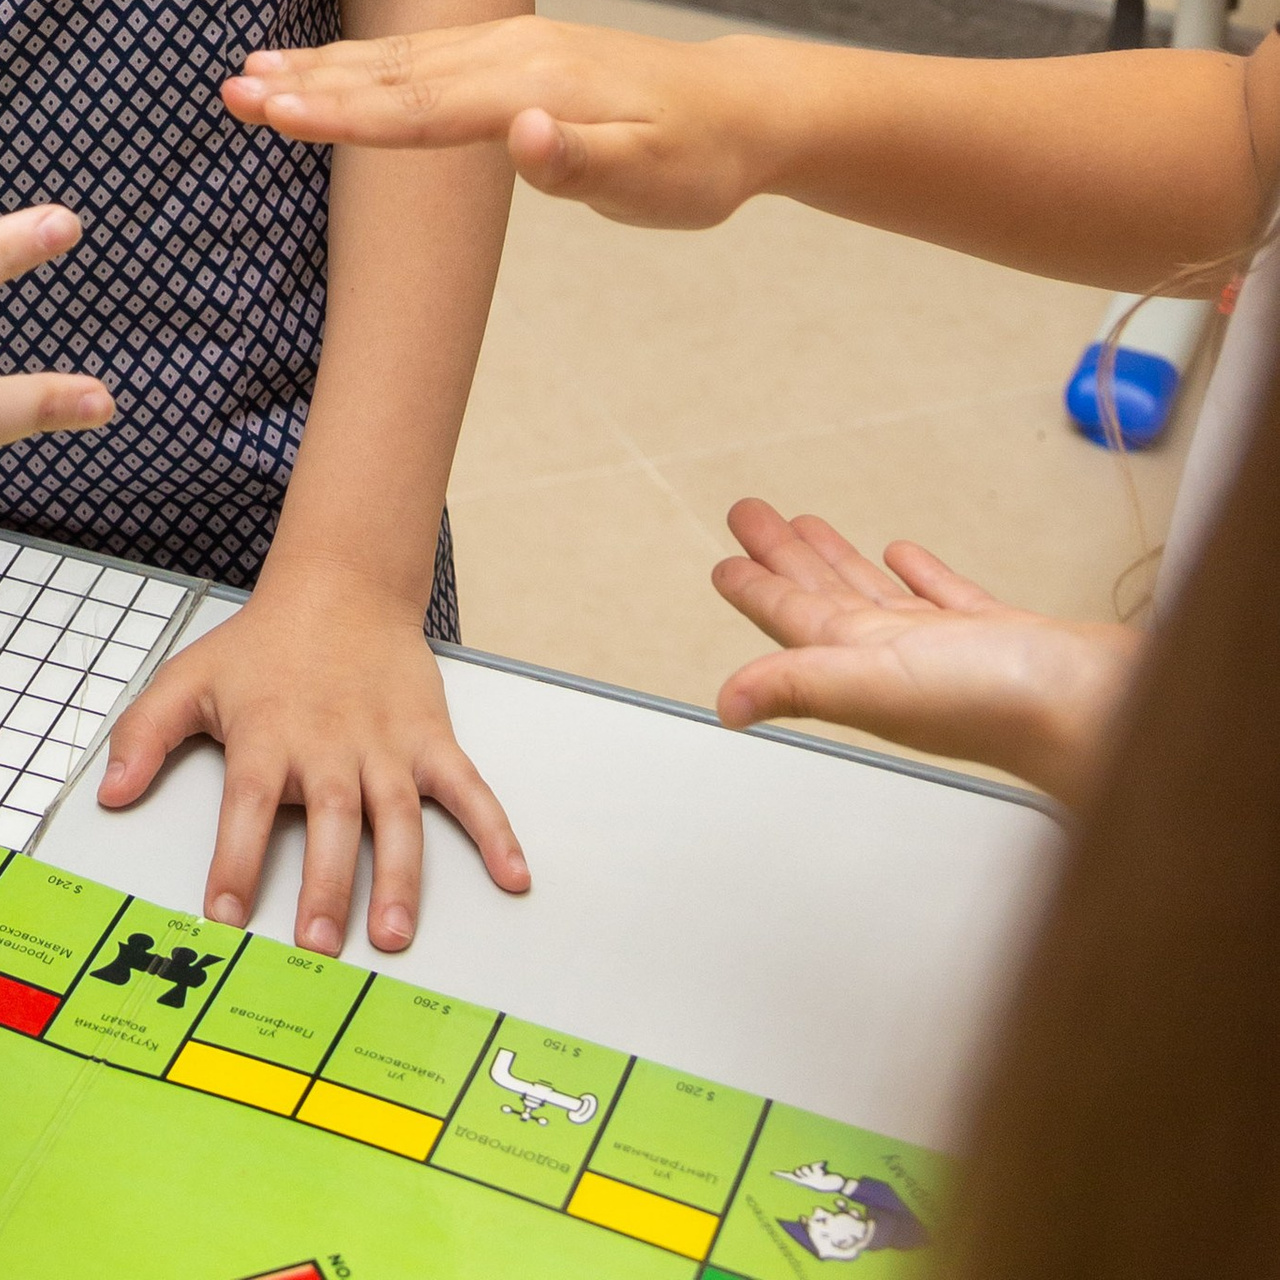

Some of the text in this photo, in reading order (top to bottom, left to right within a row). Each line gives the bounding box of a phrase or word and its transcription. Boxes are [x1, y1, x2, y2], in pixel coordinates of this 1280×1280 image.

[74, 1017, 159, 1052] Кутузовский
[100, 1013, 147, 1033] вокзал
[229, 1006, 315, 1040] Панфилова
[354, 1046, 446, 1085] Чайковского
[454, 1124, 572, 1174] ВОДОПРОВОД
